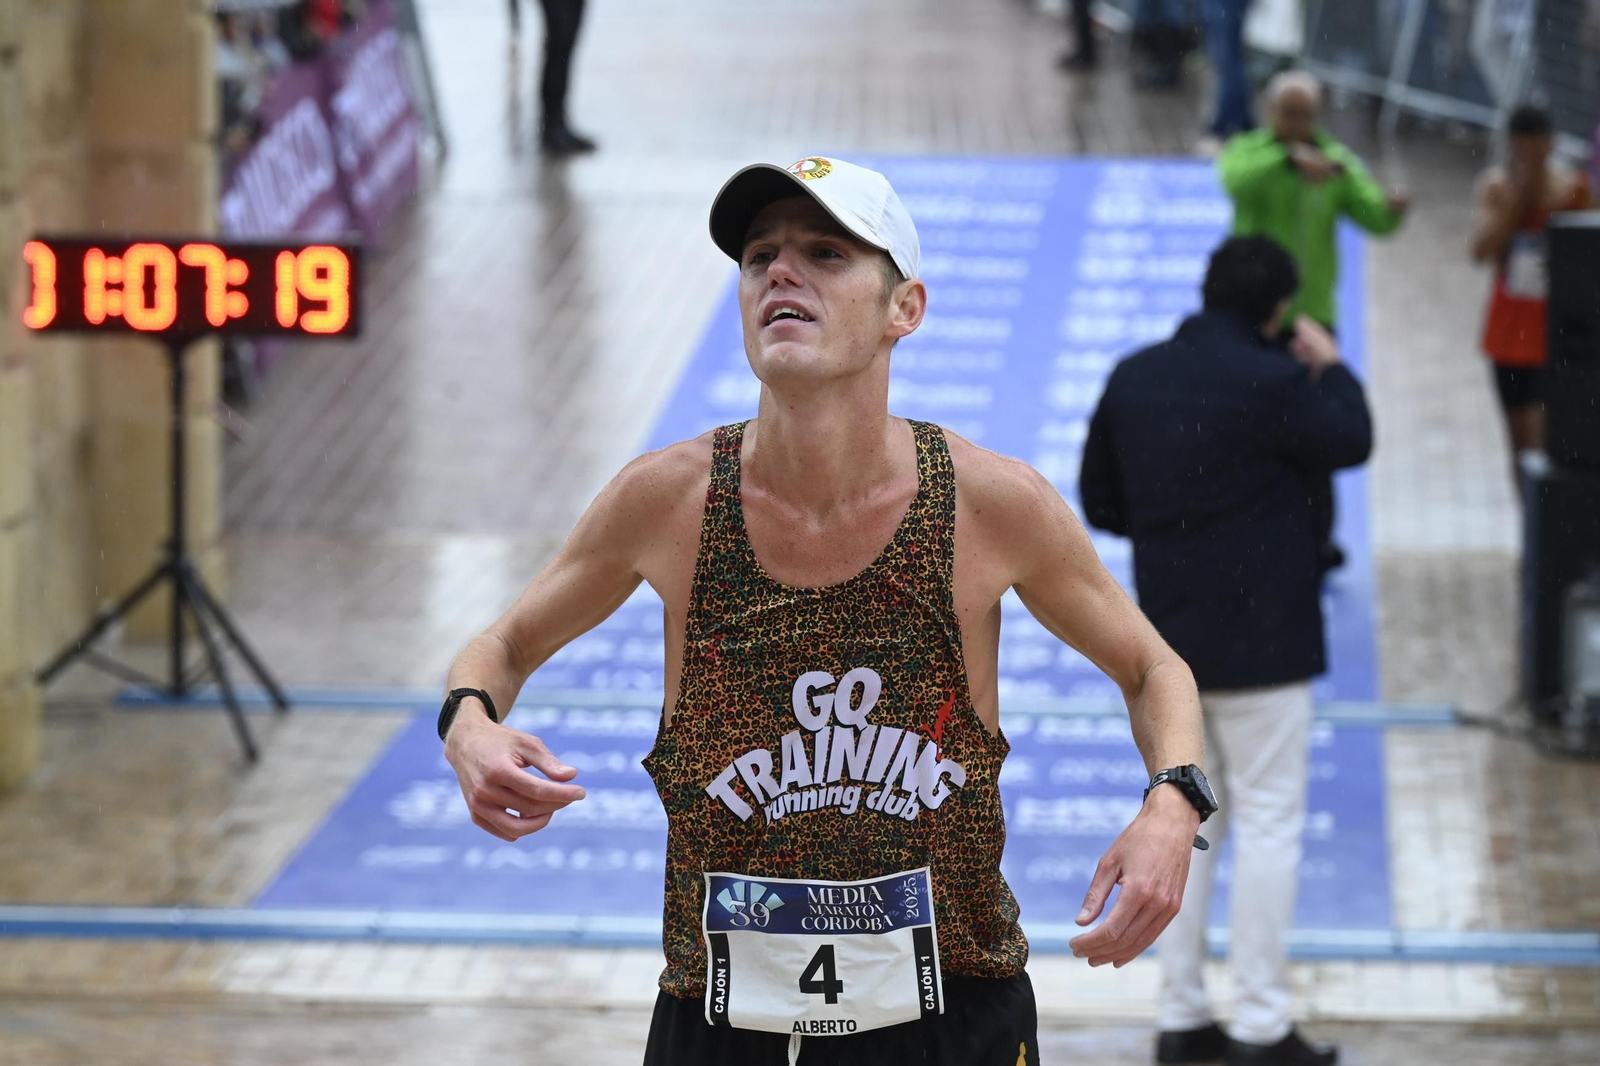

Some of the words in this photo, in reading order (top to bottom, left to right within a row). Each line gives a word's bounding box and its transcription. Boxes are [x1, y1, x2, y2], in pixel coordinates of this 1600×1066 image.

[705, 725, 967, 823] TRAINING
[763, 785, 862, 826] running
[866, 782, 920, 822] club
[729, 900, 772, 927] 39
[806, 885, 884, 905] MEDIA
[903, 876, 920, 918] 2025
[801, 914, 894, 931] CÓRDOBA
[714, 968, 728, 1014] CAJÓN
[798, 944, 843, 1005] 4
[921, 966, 935, 1010] CAJÓN
[791, 1019, 857, 1034] ALBERTO
